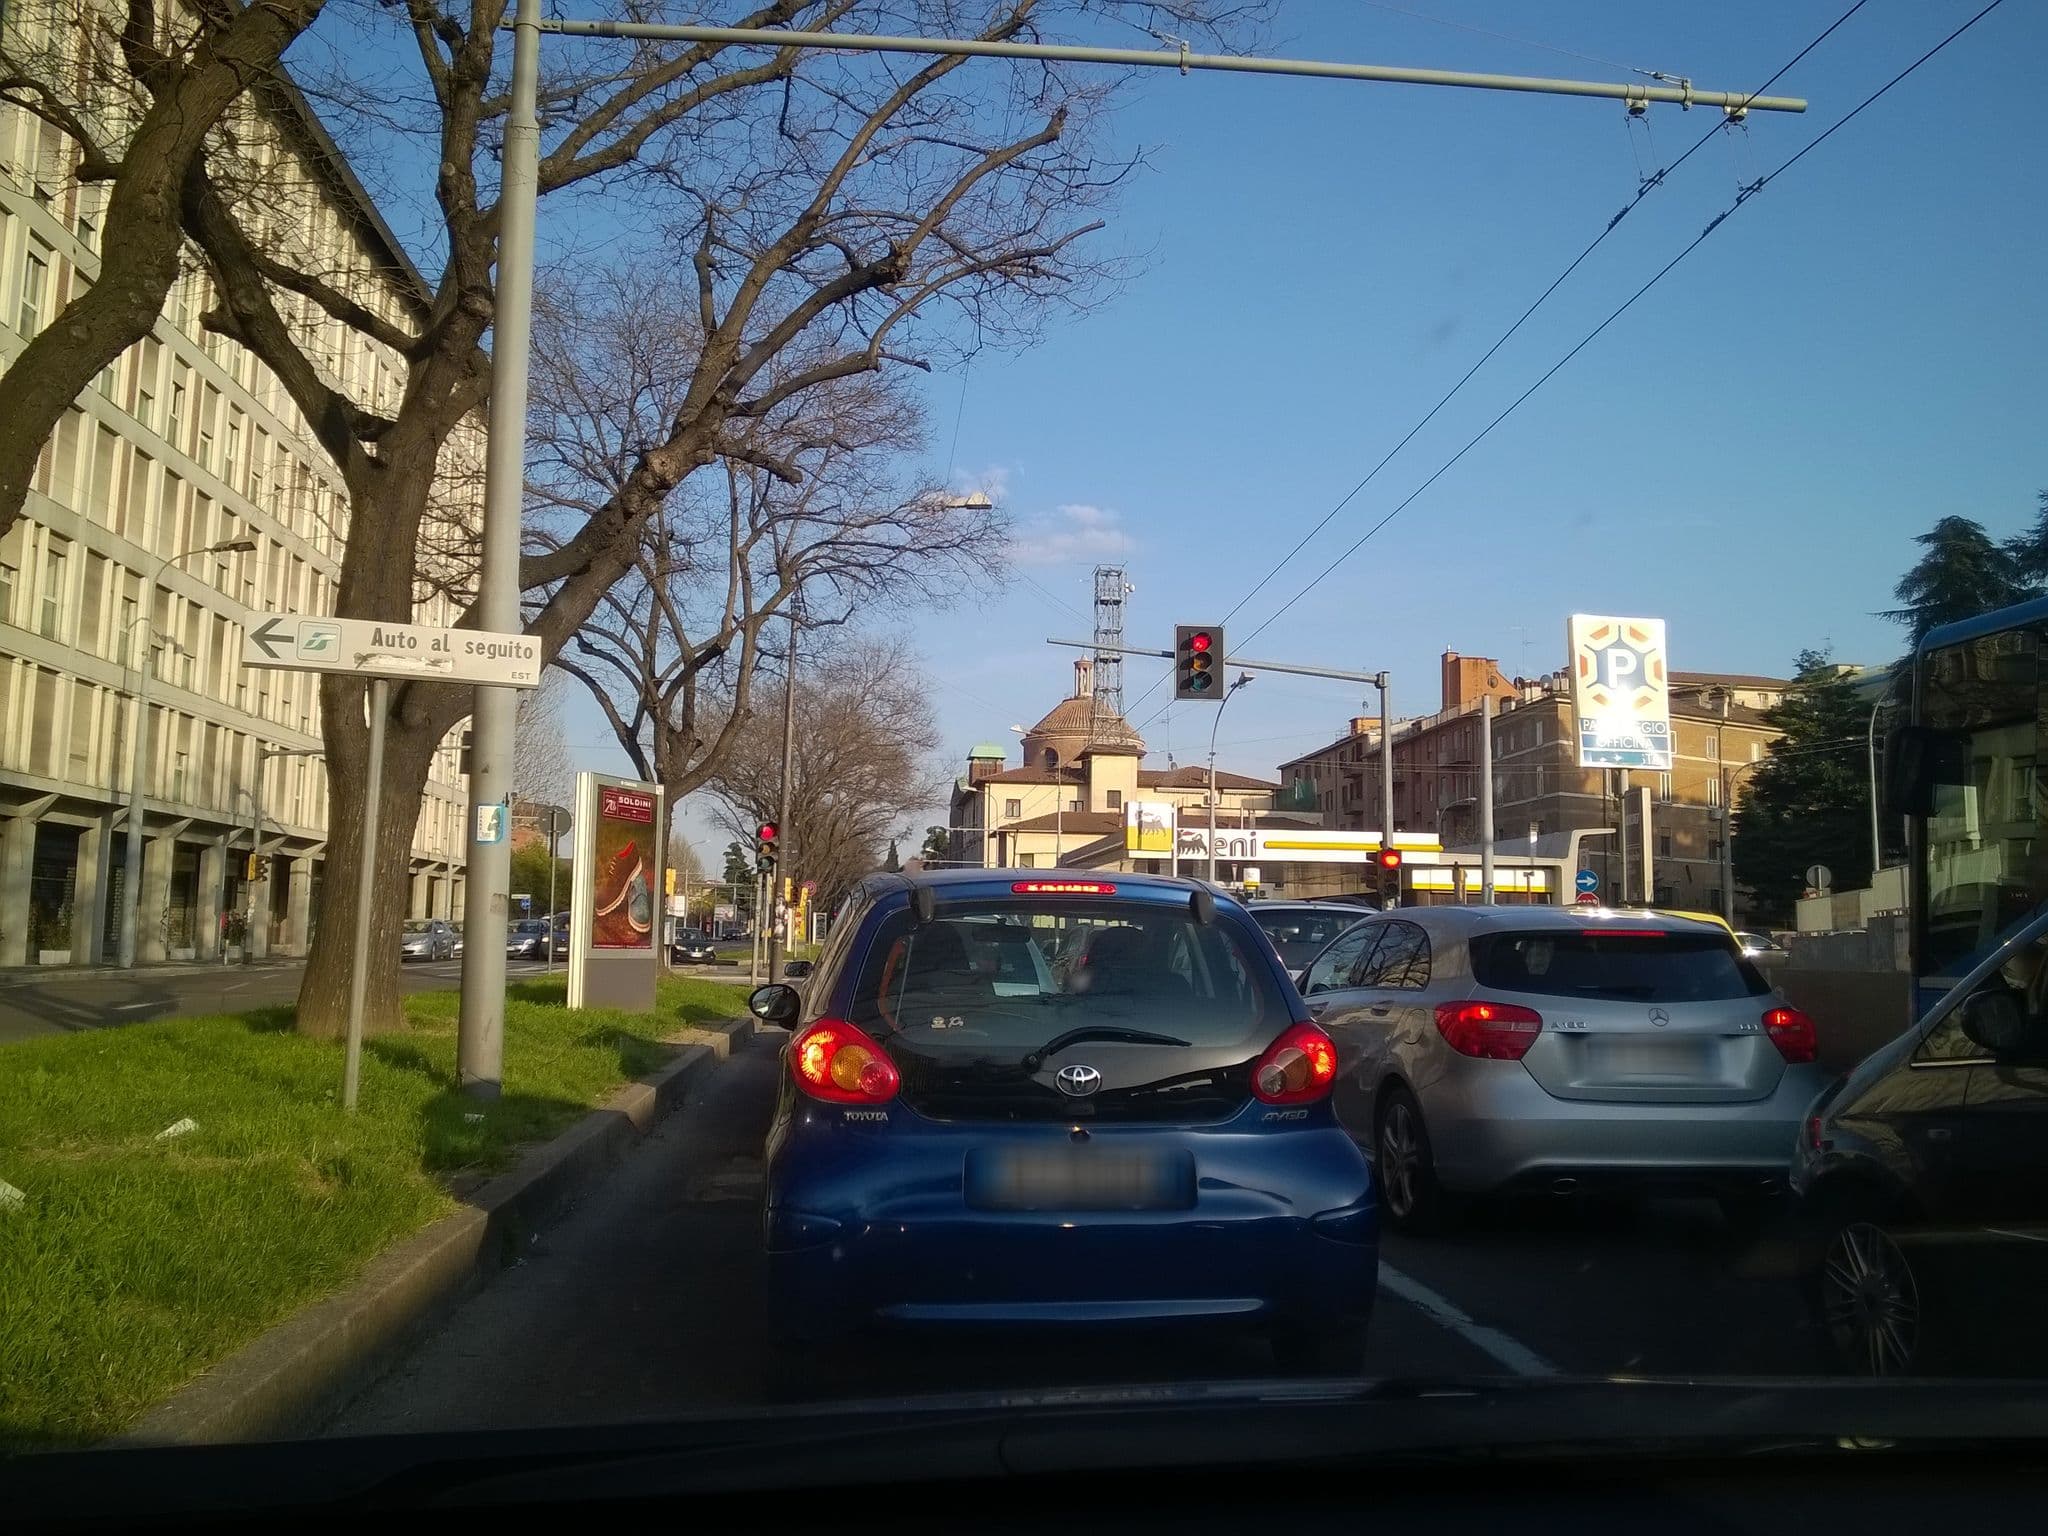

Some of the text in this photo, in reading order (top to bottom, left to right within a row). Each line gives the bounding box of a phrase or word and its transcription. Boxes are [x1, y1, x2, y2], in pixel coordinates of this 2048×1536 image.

[371, 627, 533, 660] Auto al seguito
[511, 671, 531, 681] EST
[1606, 648, 1638, 689] P
[618, 796, 651, 809] SOLDINI
[1214, 831, 1257, 857] eni
[843, 1111, 889, 1121] TOYOTA
